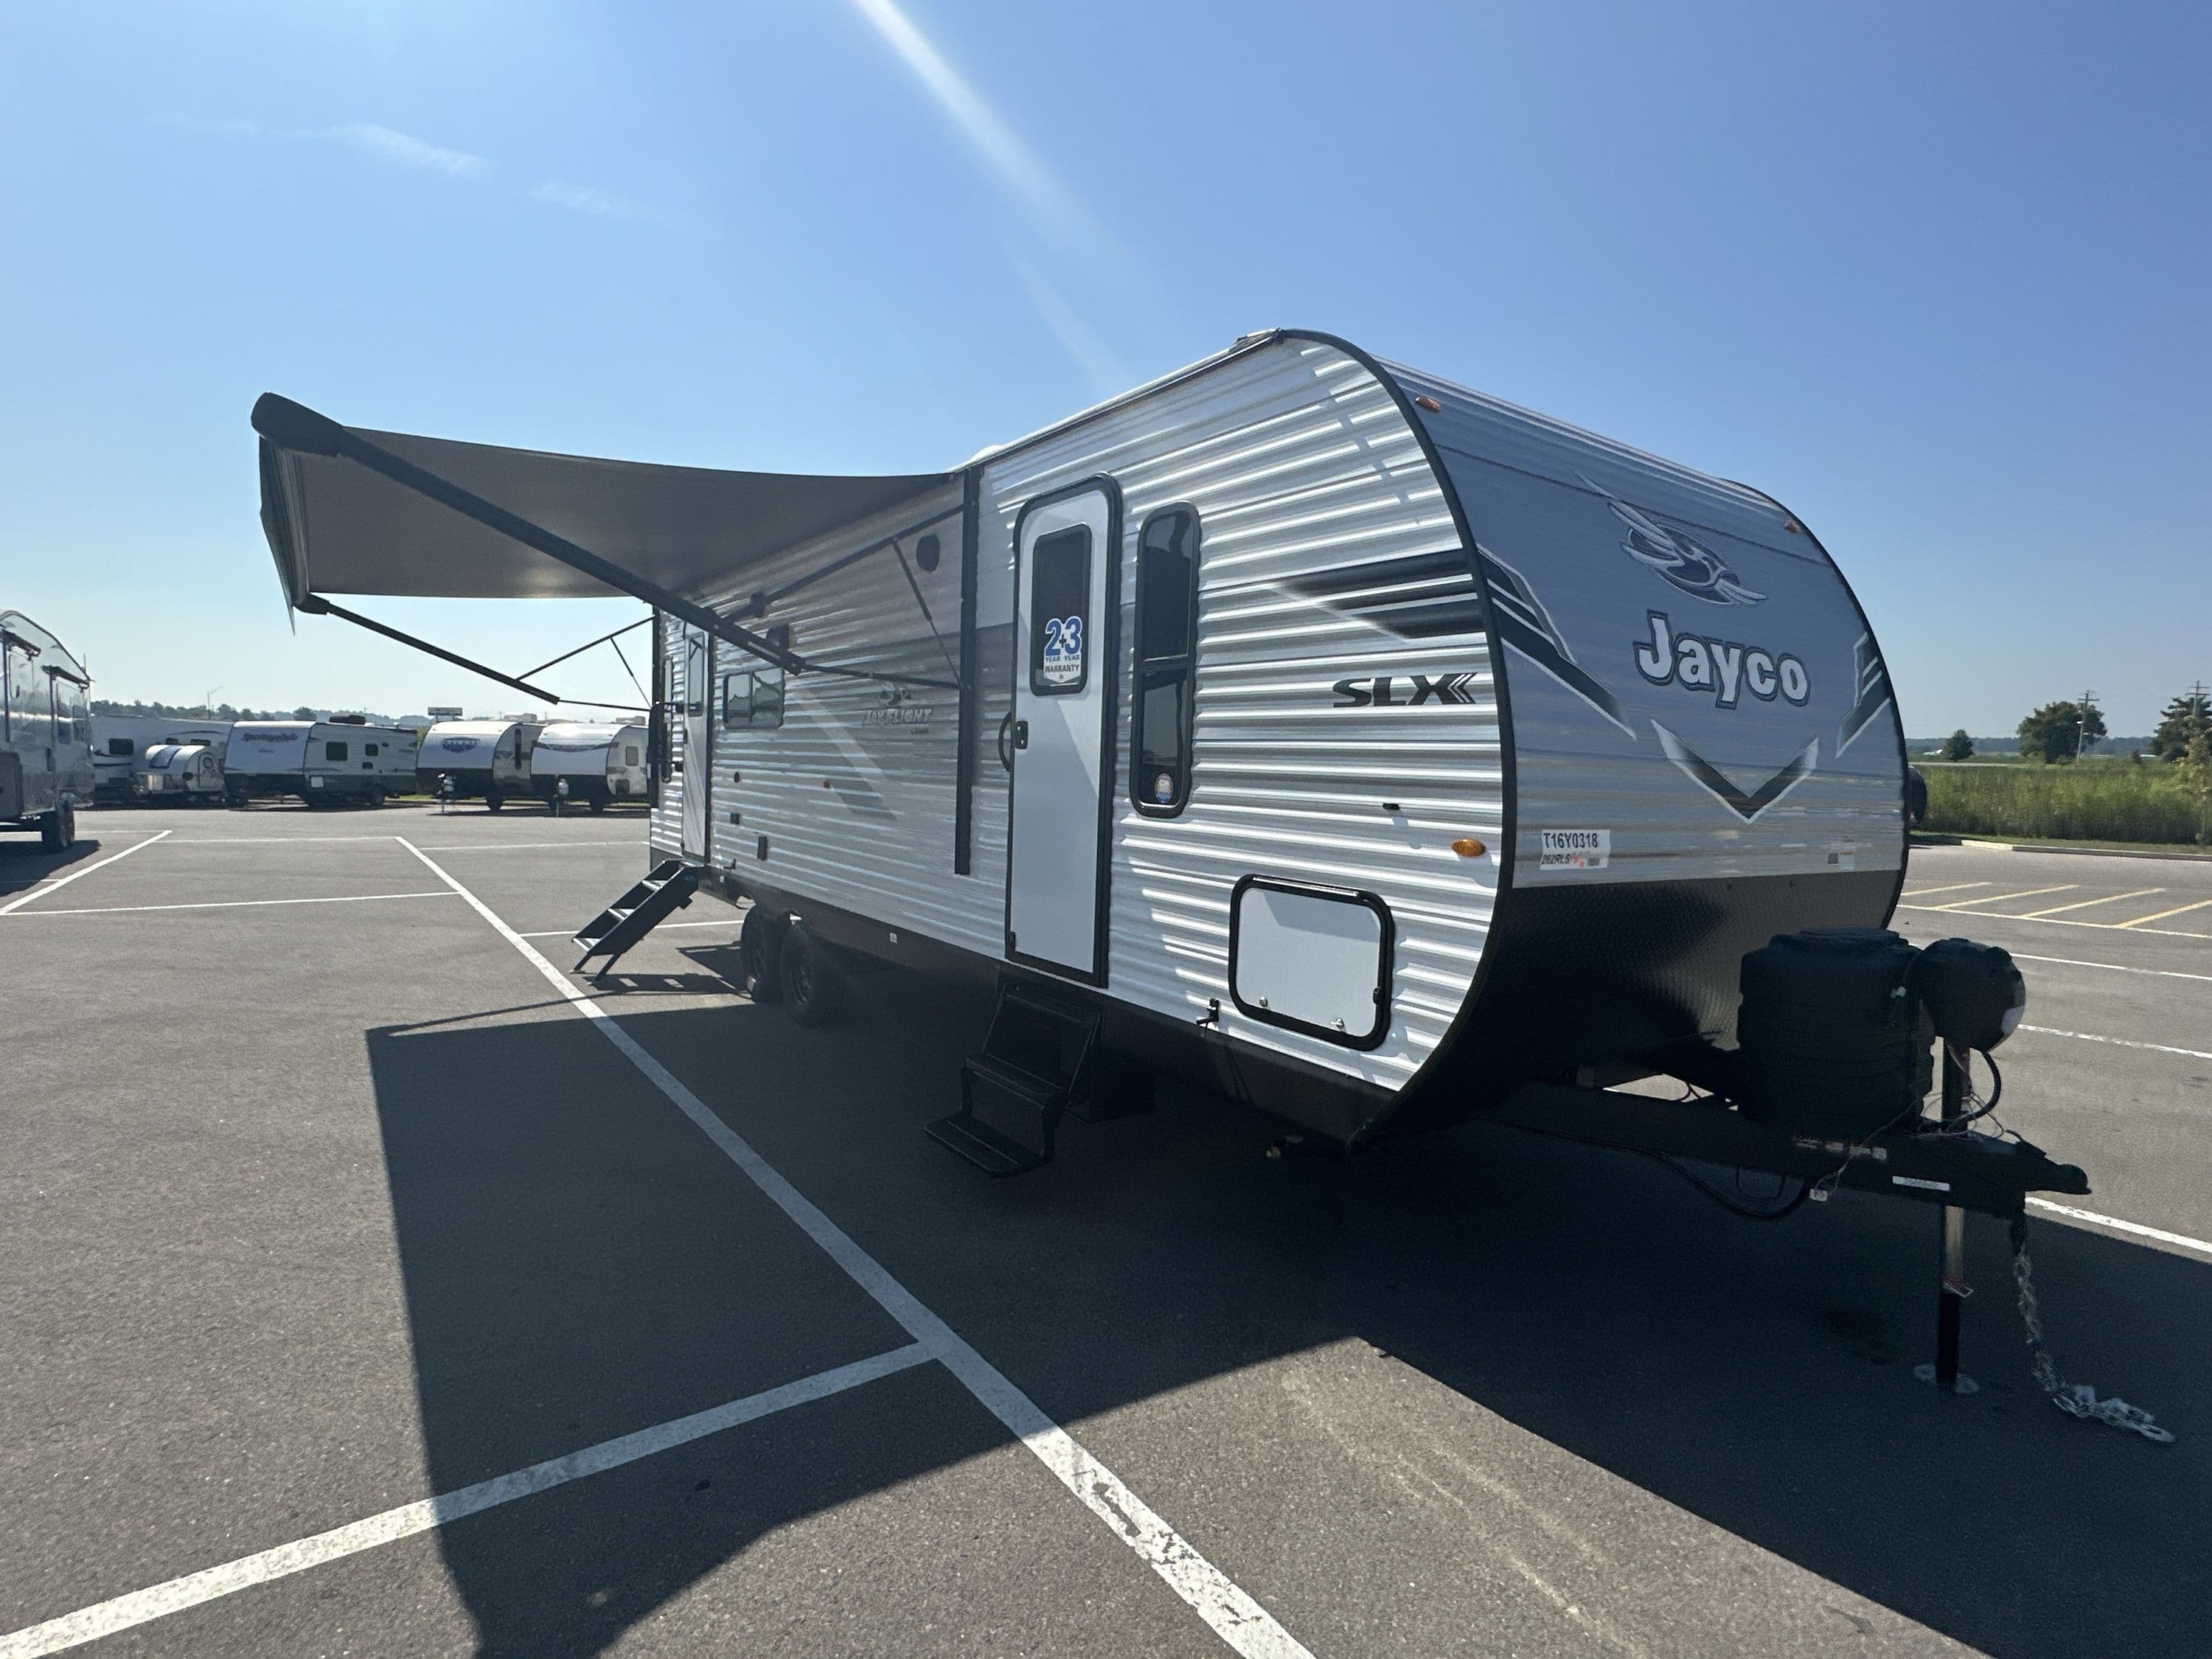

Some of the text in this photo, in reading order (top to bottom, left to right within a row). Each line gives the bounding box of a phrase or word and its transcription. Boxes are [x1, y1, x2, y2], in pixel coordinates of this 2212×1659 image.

[1045, 664, 1079, 672] WARRANTY
[1633, 609, 1811, 709] Jayco
[1332, 672, 1477, 707] SLX
[1544, 832, 1599, 849] T16Y0318
